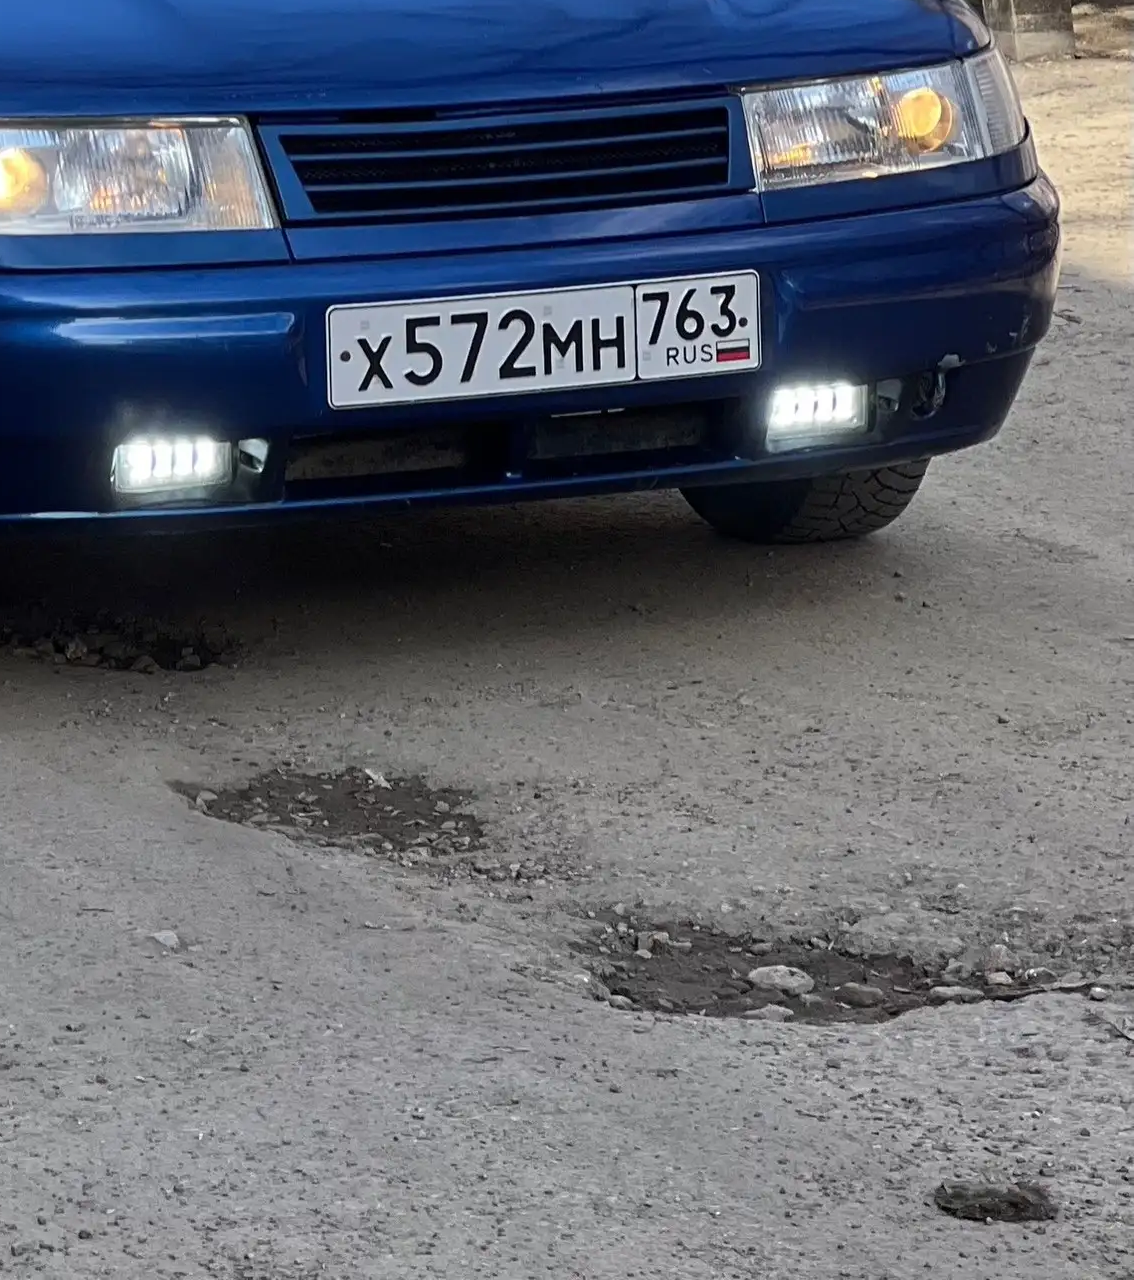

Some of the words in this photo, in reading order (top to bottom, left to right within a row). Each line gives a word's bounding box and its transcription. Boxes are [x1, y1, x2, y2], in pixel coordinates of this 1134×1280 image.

[356, 308, 626, 392] Х572МН
[641, 284, 737, 346] 763
[666, 343, 713, 366] RUS
